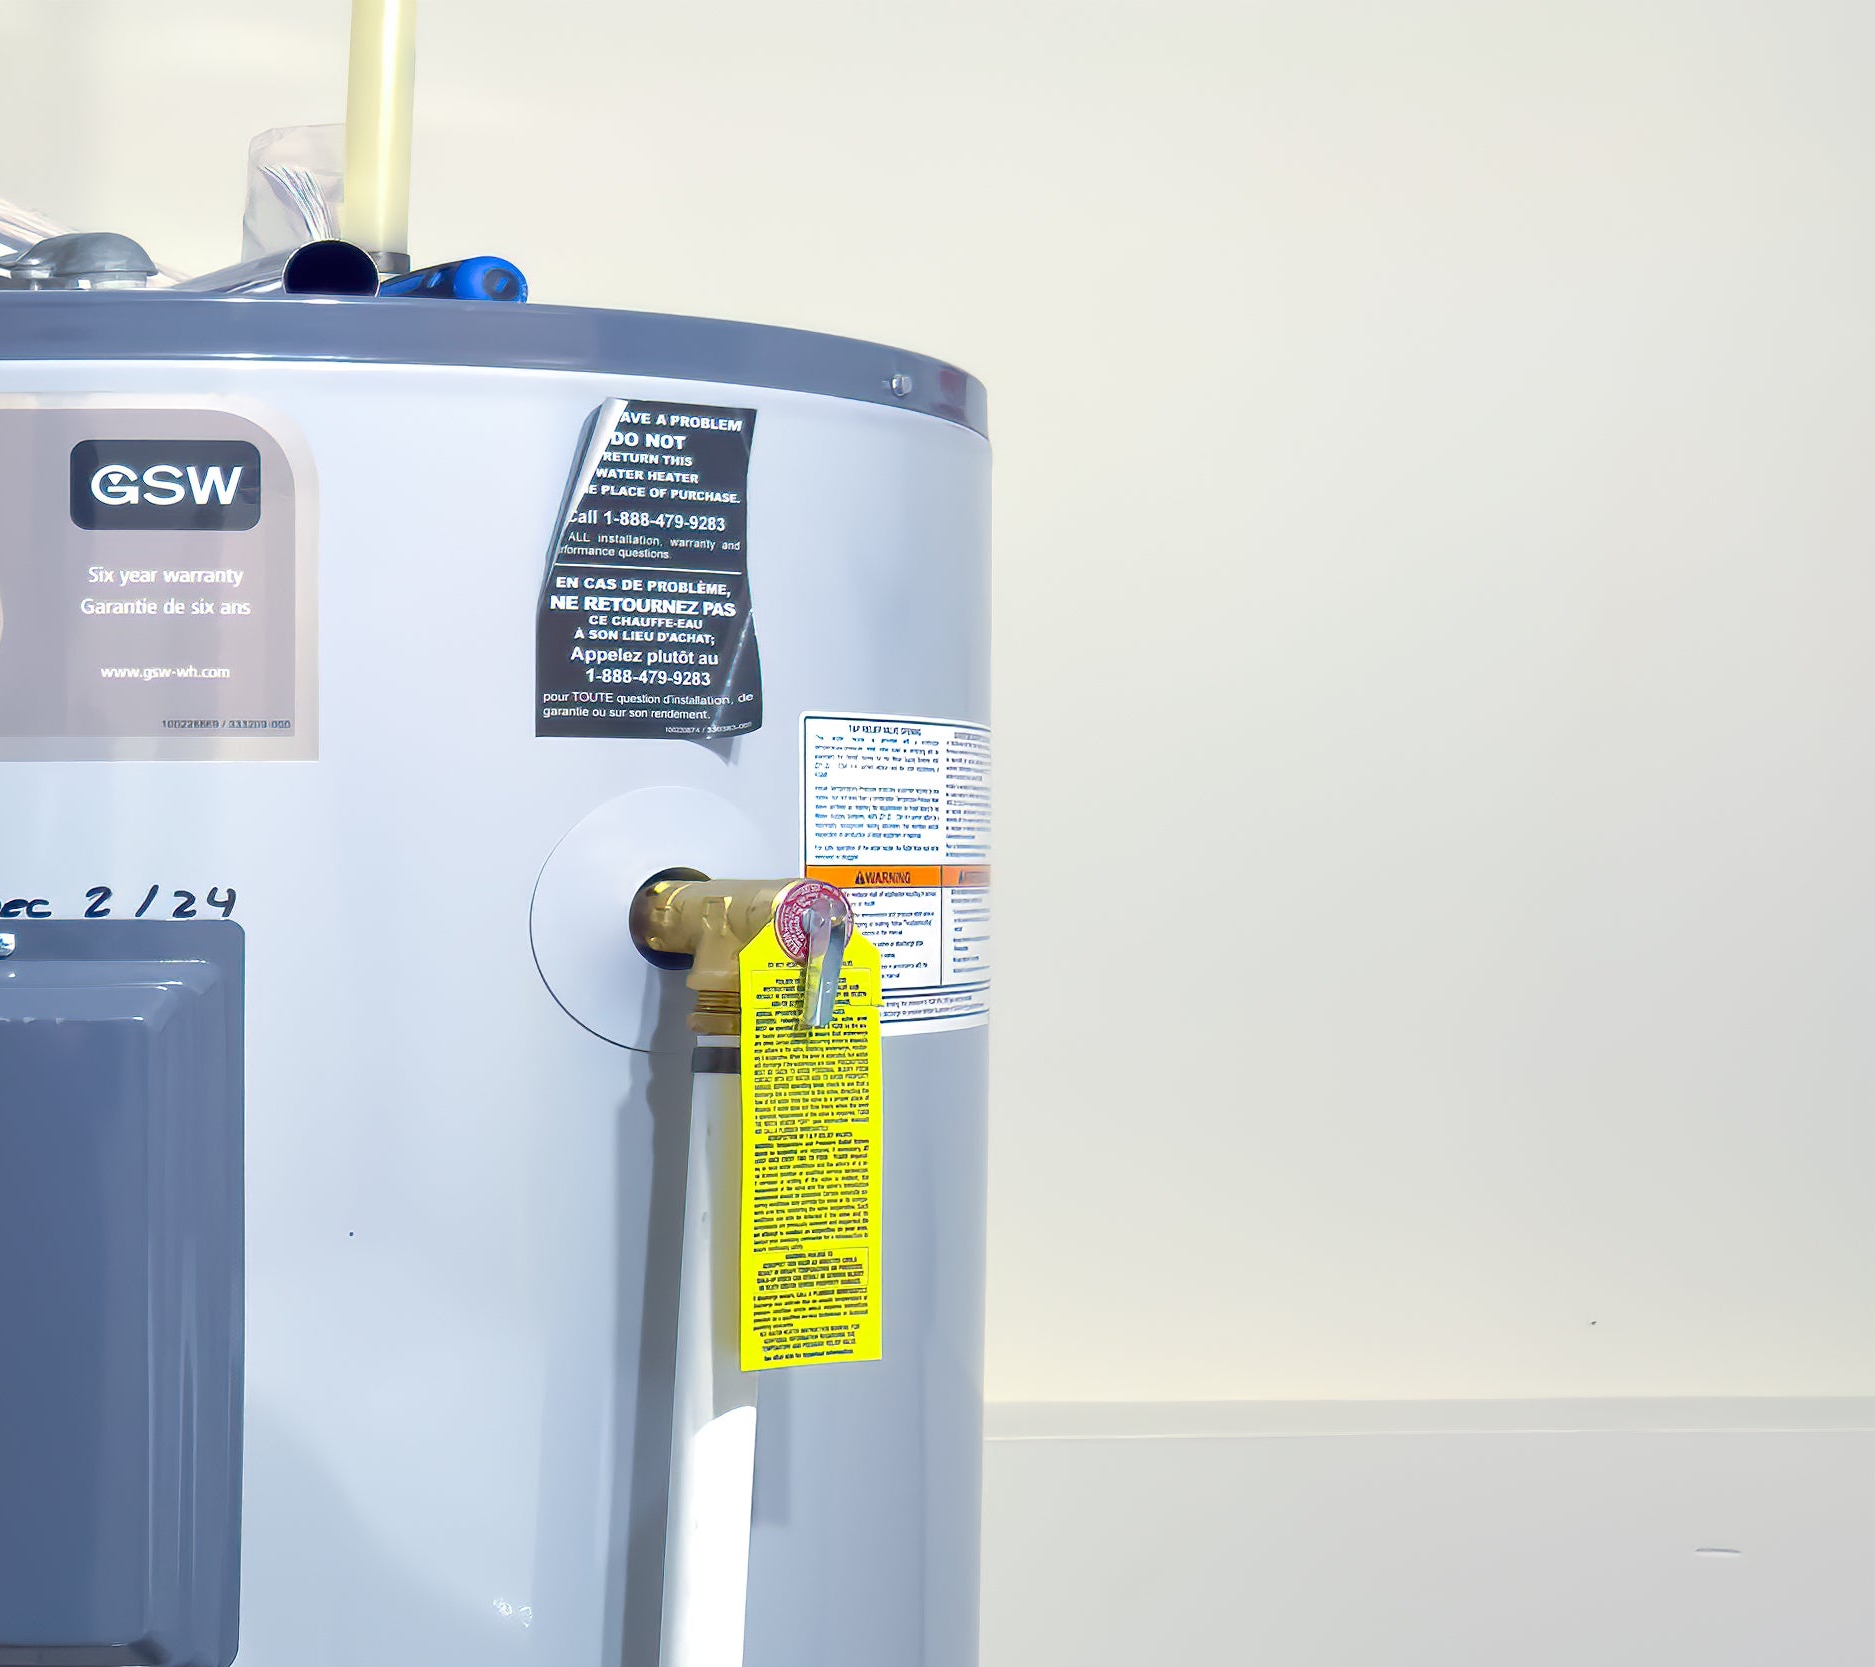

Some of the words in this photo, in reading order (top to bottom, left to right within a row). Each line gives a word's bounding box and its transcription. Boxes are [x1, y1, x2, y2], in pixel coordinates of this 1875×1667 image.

[655, 413, 666, 427] A
[669, 414, 742, 431] PROBLEM
[611, 431, 639, 447] DO
[645, 433, 685, 450] NOT
[602, 451, 658, 465] RETURN
[662, 454, 692, 467] THIS
[595, 467, 644, 481] WATER
[647, 470, 698, 484] HEATER
[90, 464, 244, 507] GSW
[600, 485, 645, 498] PLACE
[649, 488, 666, 499] OF
[670, 489, 740, 504] PURCHASE.
[567, 509, 597, 524] Call
[603, 511, 725, 532] 1-888-479-9283
[568, 532, 590, 543] ALL
[598, 533, 662, 548] installation,
[670, 537, 715, 552] warranty
[721, 540, 740, 551] and
[618, 546, 669, 561] questions.
[88, 566, 114, 583] Six
[119, 570, 158, 587] year
[162, 566, 244, 588] warranty
[555, 577, 578, 589] EN
[583, 578, 617, 590] CAS
[621, 579, 643, 591] DE
[647, 578, 730, 597] PROBLÈME,
[80, 597, 157, 615] Garantie
[163, 598, 185, 615] de
[191, 598, 214, 615] six
[219, 602, 251, 616] ans
[550, 596, 579, 611] NE
[583, 597, 699, 616] RETOURNEZ
[702, 602, 736, 617] PAS
[588, 615, 607, 626] CE
[611, 616, 702, 630] CHAUFFE-EAU
[573, 626, 585, 640] À
[588, 630, 618, 641] SON
[622, 631, 654, 643] LIEU
[657, 632, 715, 646] D'ACHAT;
[570, 647, 642, 666] Appelez
[647, 650, 694, 668] plutôt
[698, 654, 718, 666] au
[100, 664, 231, 681] www.gsw-wh.com
[585, 668, 710, 687] 1-888-479-9283
[543, 694, 569, 705] pour
[574, 692, 613, 703] TOUTE
[616, 693, 660, 706] question
[662, 693, 733, 706] d'installation,
[737, 691, 753, 704] de
[542, 706, 589, 720] garantie
[592, 709, 606, 718] ou
[608, 710, 626, 718] sur
[628, 710, 647, 719] son
[650, 708, 710, 720] rendement.
[85, 885, 112, 919] 2
[172, 885, 237, 919] 24
